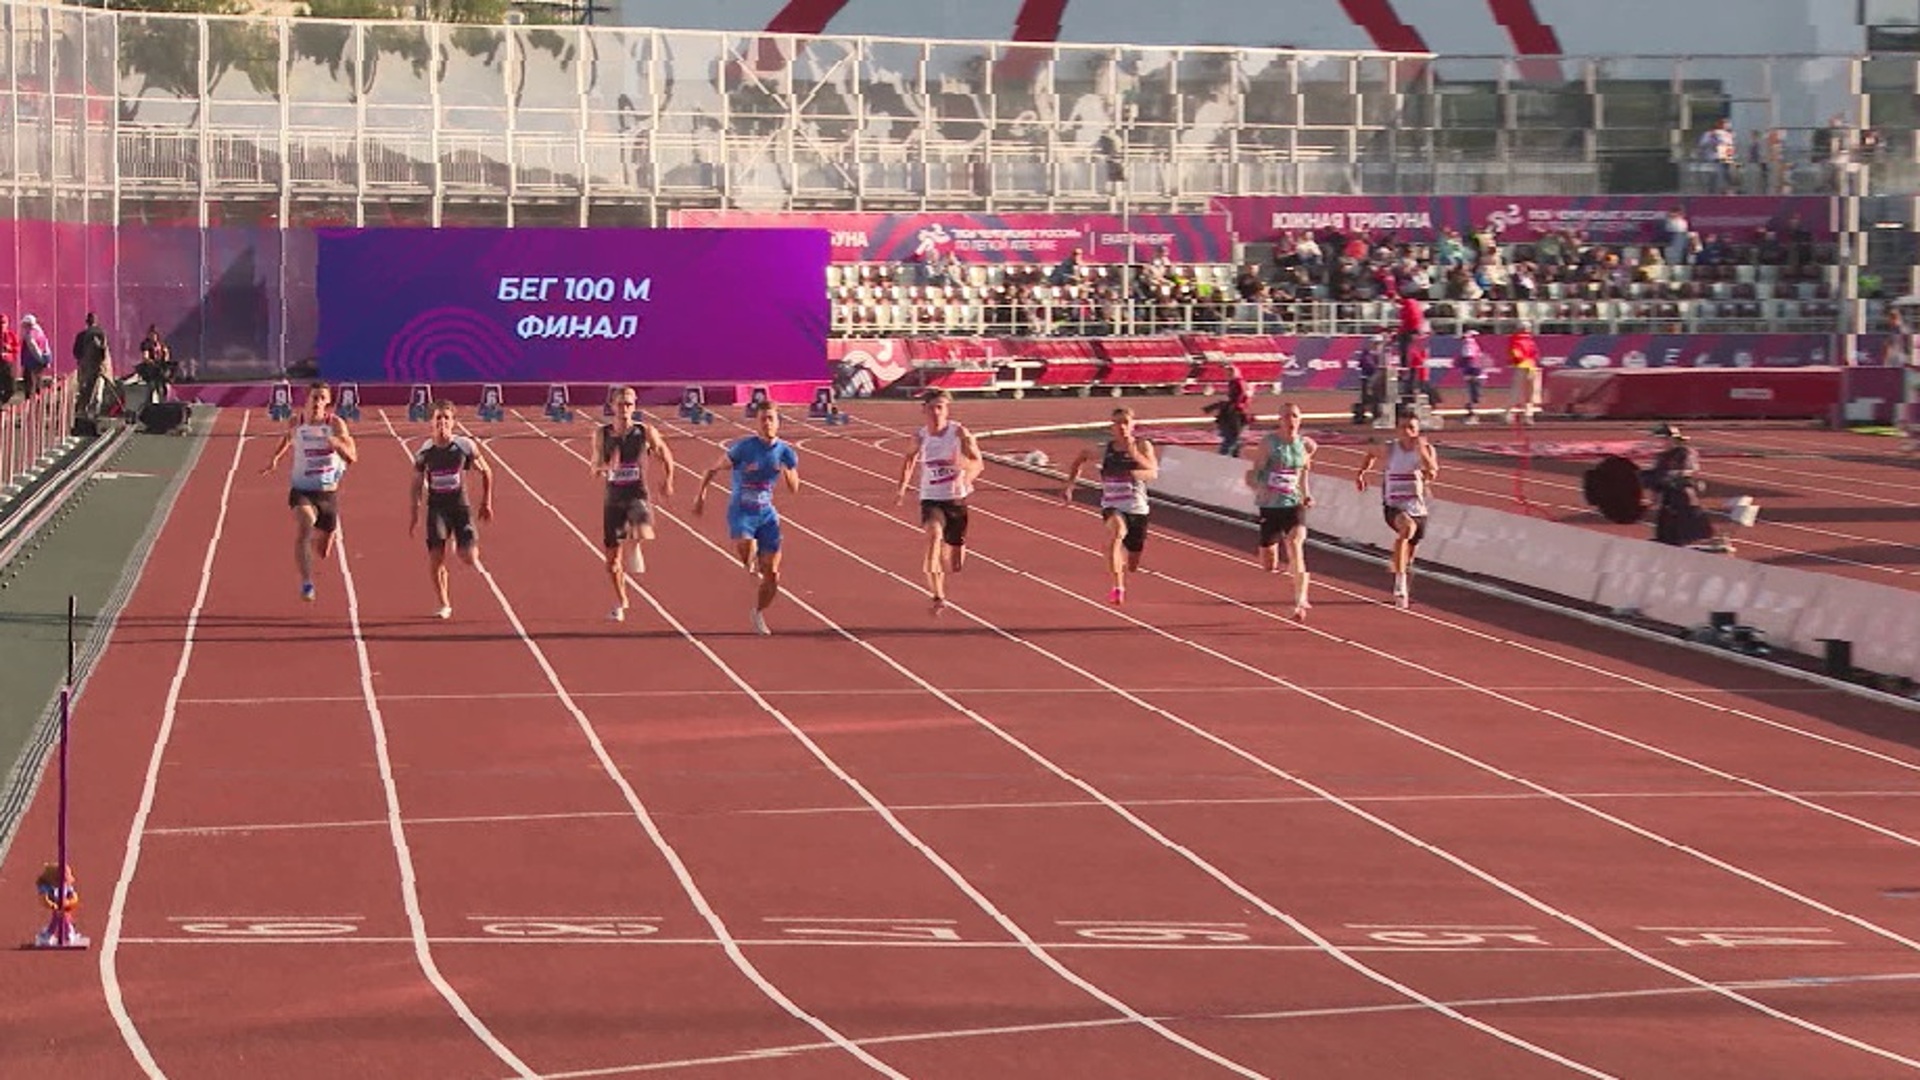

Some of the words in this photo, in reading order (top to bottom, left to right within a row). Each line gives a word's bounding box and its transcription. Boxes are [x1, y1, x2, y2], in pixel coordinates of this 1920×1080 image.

[1272, 212, 1344, 228] ЮЖНАЯ
[1347, 212, 1432, 228] ТРИБУНА
[498, 277, 557, 301] БЕГ
[564, 277, 615, 301] 100
[623, 277, 651, 301] М
[517, 315, 638, 339] ФИНАЛ
[275, 390, 286, 405] 9
[343, 390, 354, 405] 8
[416, 390, 426, 405] 7
[487, 390, 498, 406] 6
[553, 390, 563, 406] 5
[482, 922, 659, 936] 8
[1367, 930, 1551, 946] 5
[1667, 932, 1847, 948] 4
